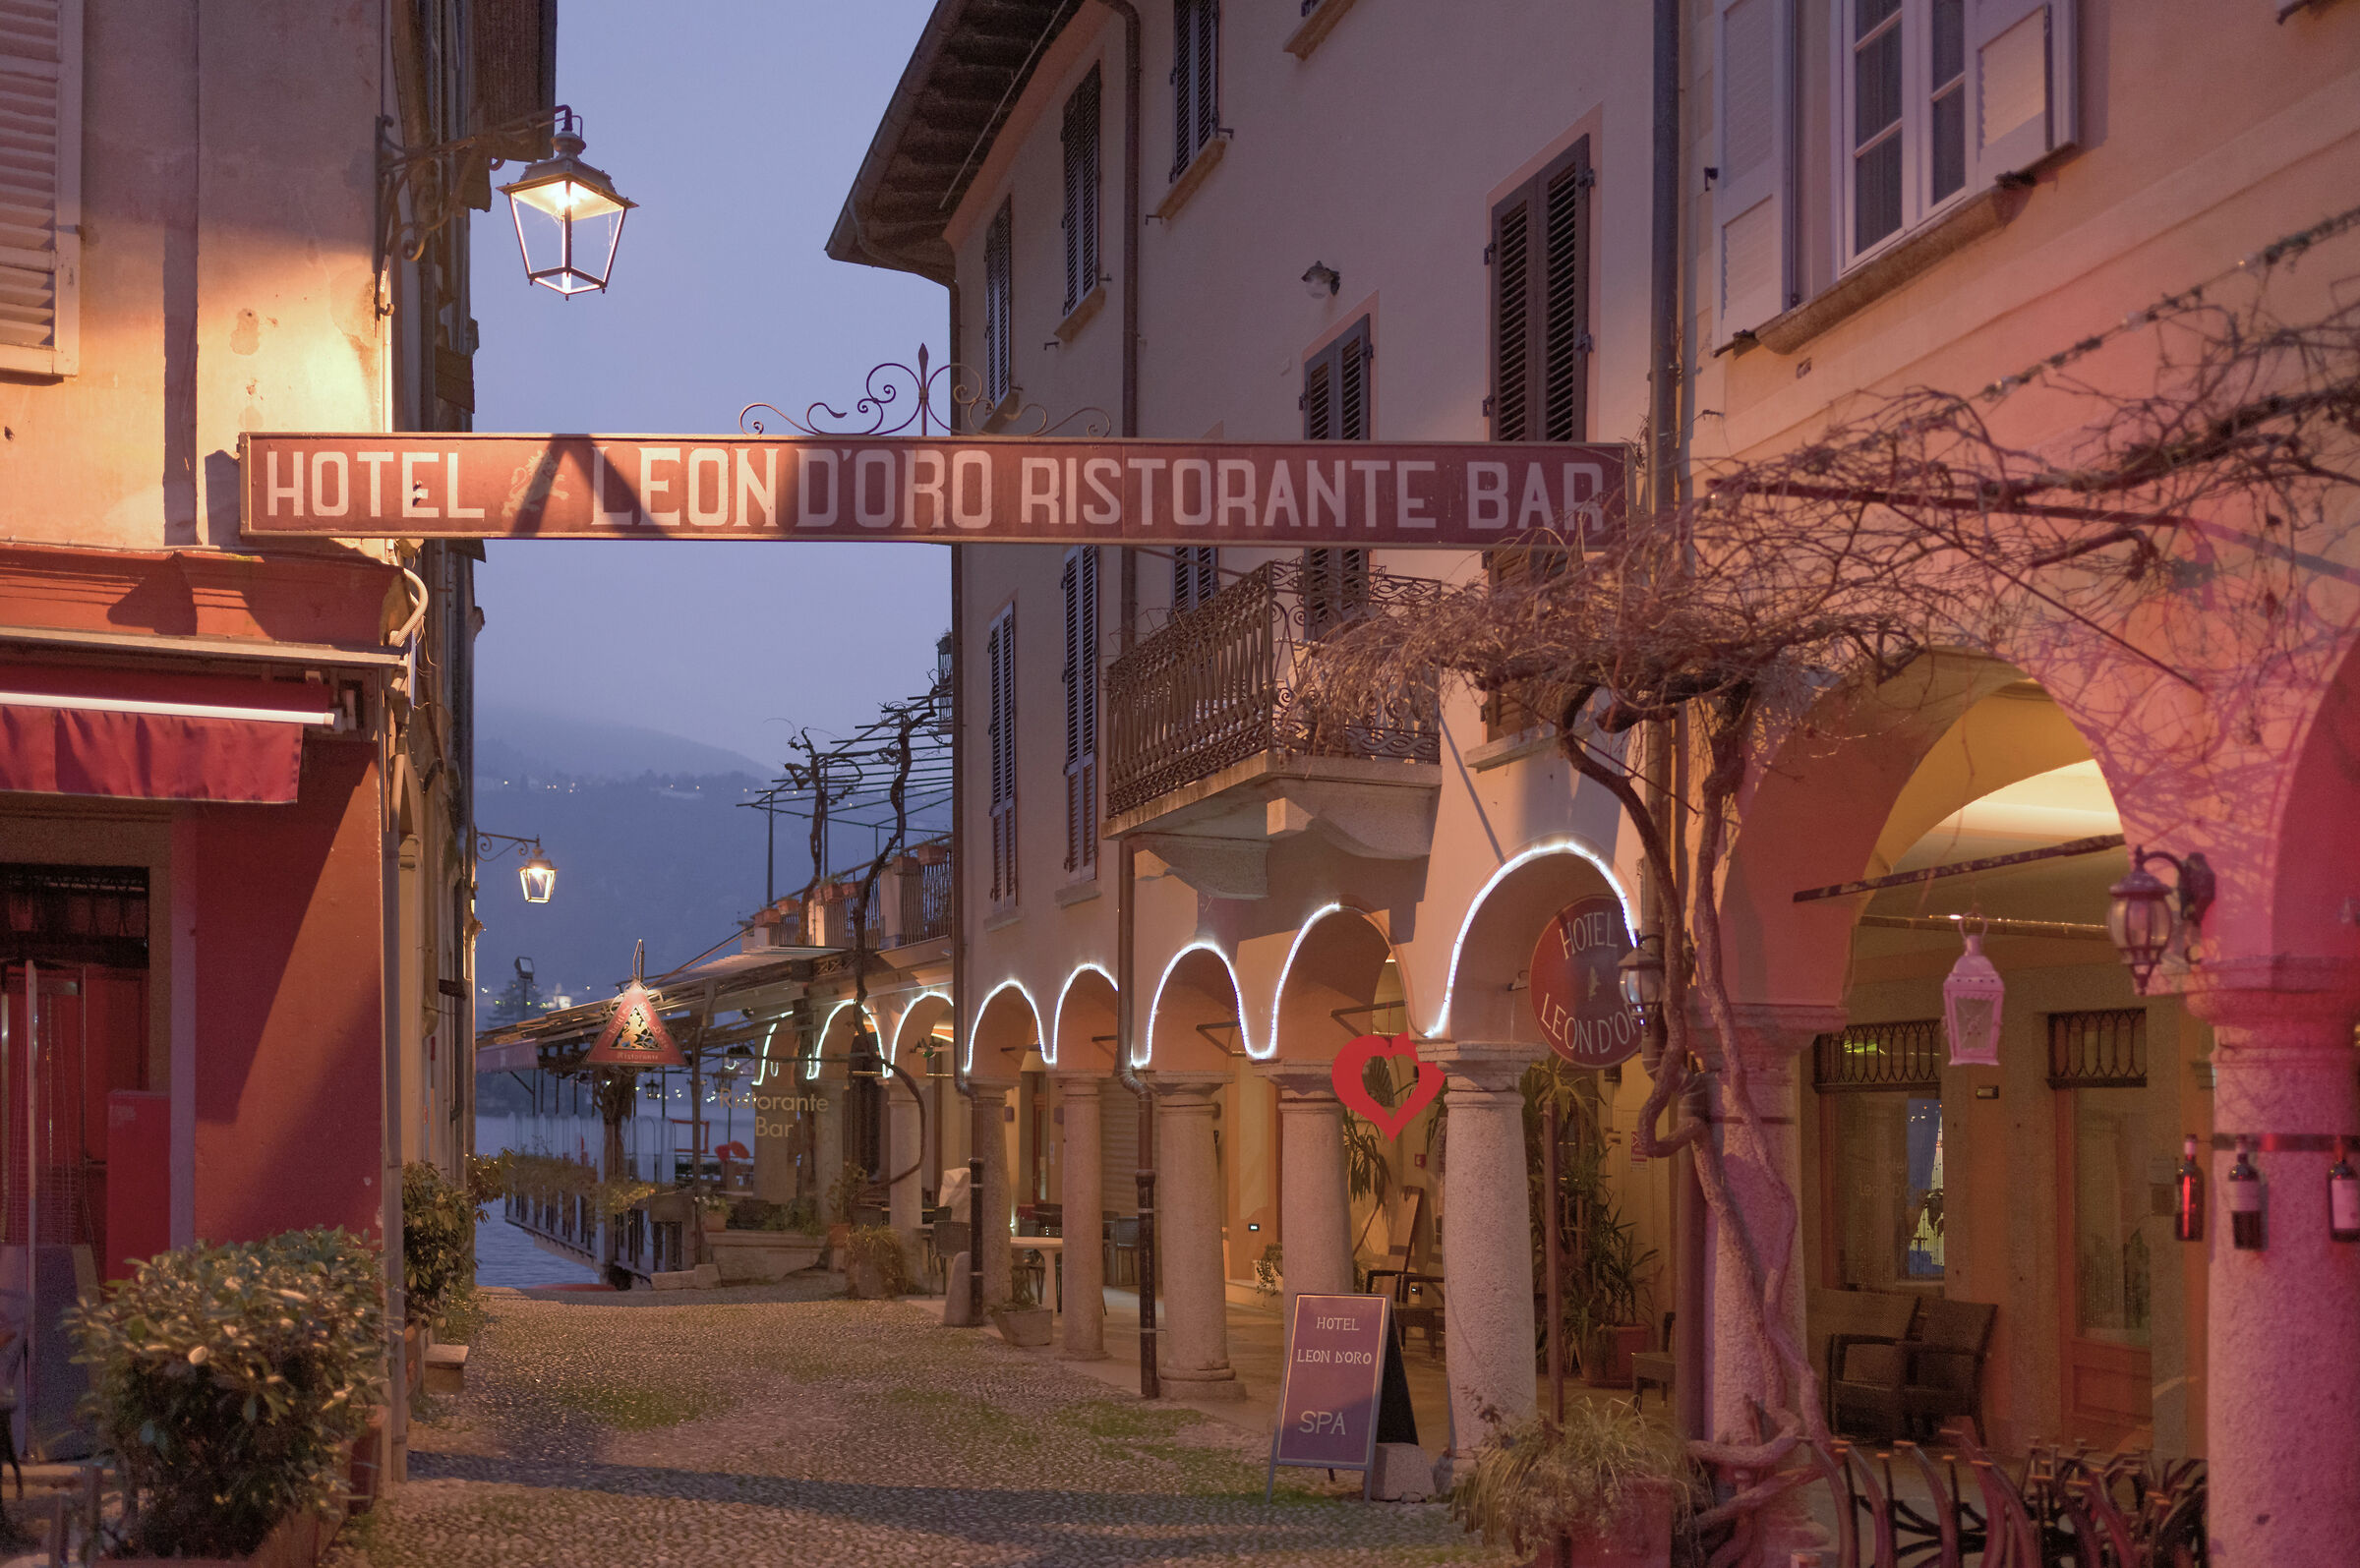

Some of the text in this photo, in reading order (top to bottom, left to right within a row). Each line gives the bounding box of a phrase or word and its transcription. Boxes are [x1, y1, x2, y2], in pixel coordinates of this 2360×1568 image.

[266, 446, 1604, 531] HOTEL LEON D'ORO RISTORANTE BAR
[1559, 911, 1618, 960] HOTEL
[1541, 993, 1593, 1055] LEON
[719, 1086, 829, 1113] Ristorante
[754, 1116, 794, 1137] Bar
[1316, 1316, 1360, 1331] HOTEL
[1296, 1349, 1372, 1365] LEON D'ORO
[1298, 1410, 1346, 1435] SPA
